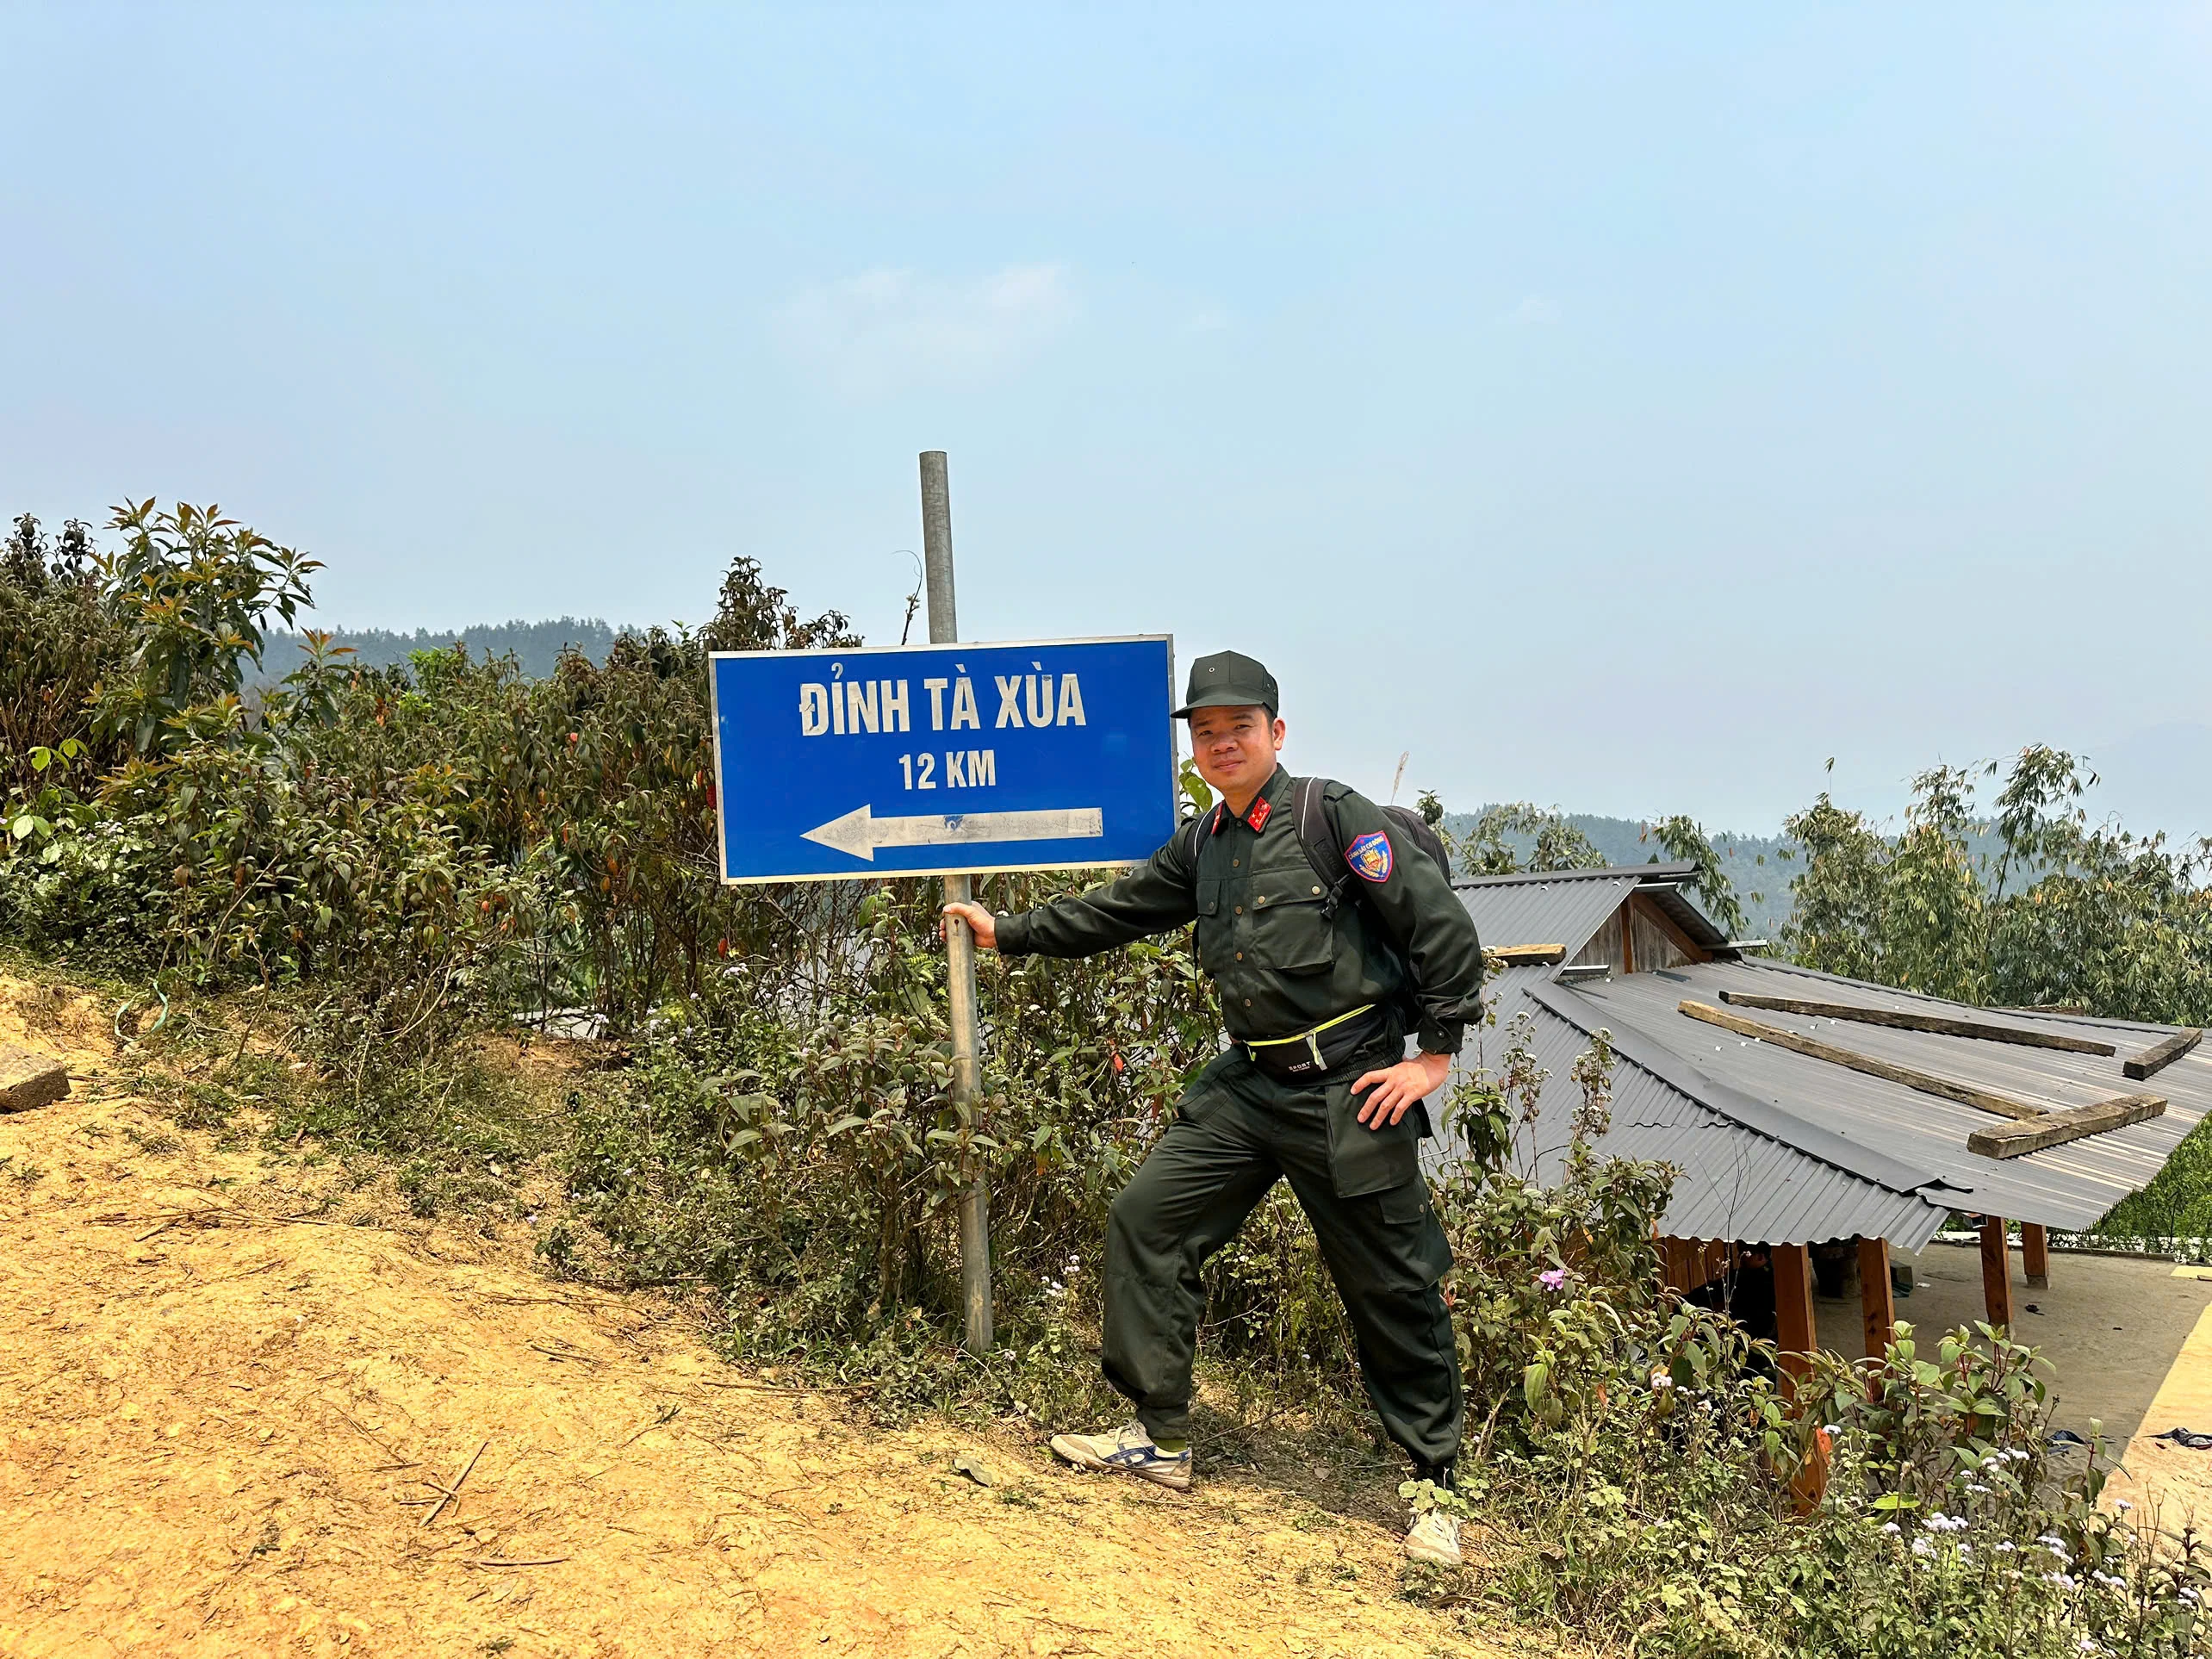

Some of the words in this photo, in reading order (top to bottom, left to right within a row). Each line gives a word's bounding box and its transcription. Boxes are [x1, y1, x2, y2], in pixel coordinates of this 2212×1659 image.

[798, 662, 910, 736] ĐỈNH
[923, 663, 981, 731] TÀ
[994, 661, 1087, 729] XÙA
[898, 753, 936, 790] 12
[946, 749, 997, 788] KM
